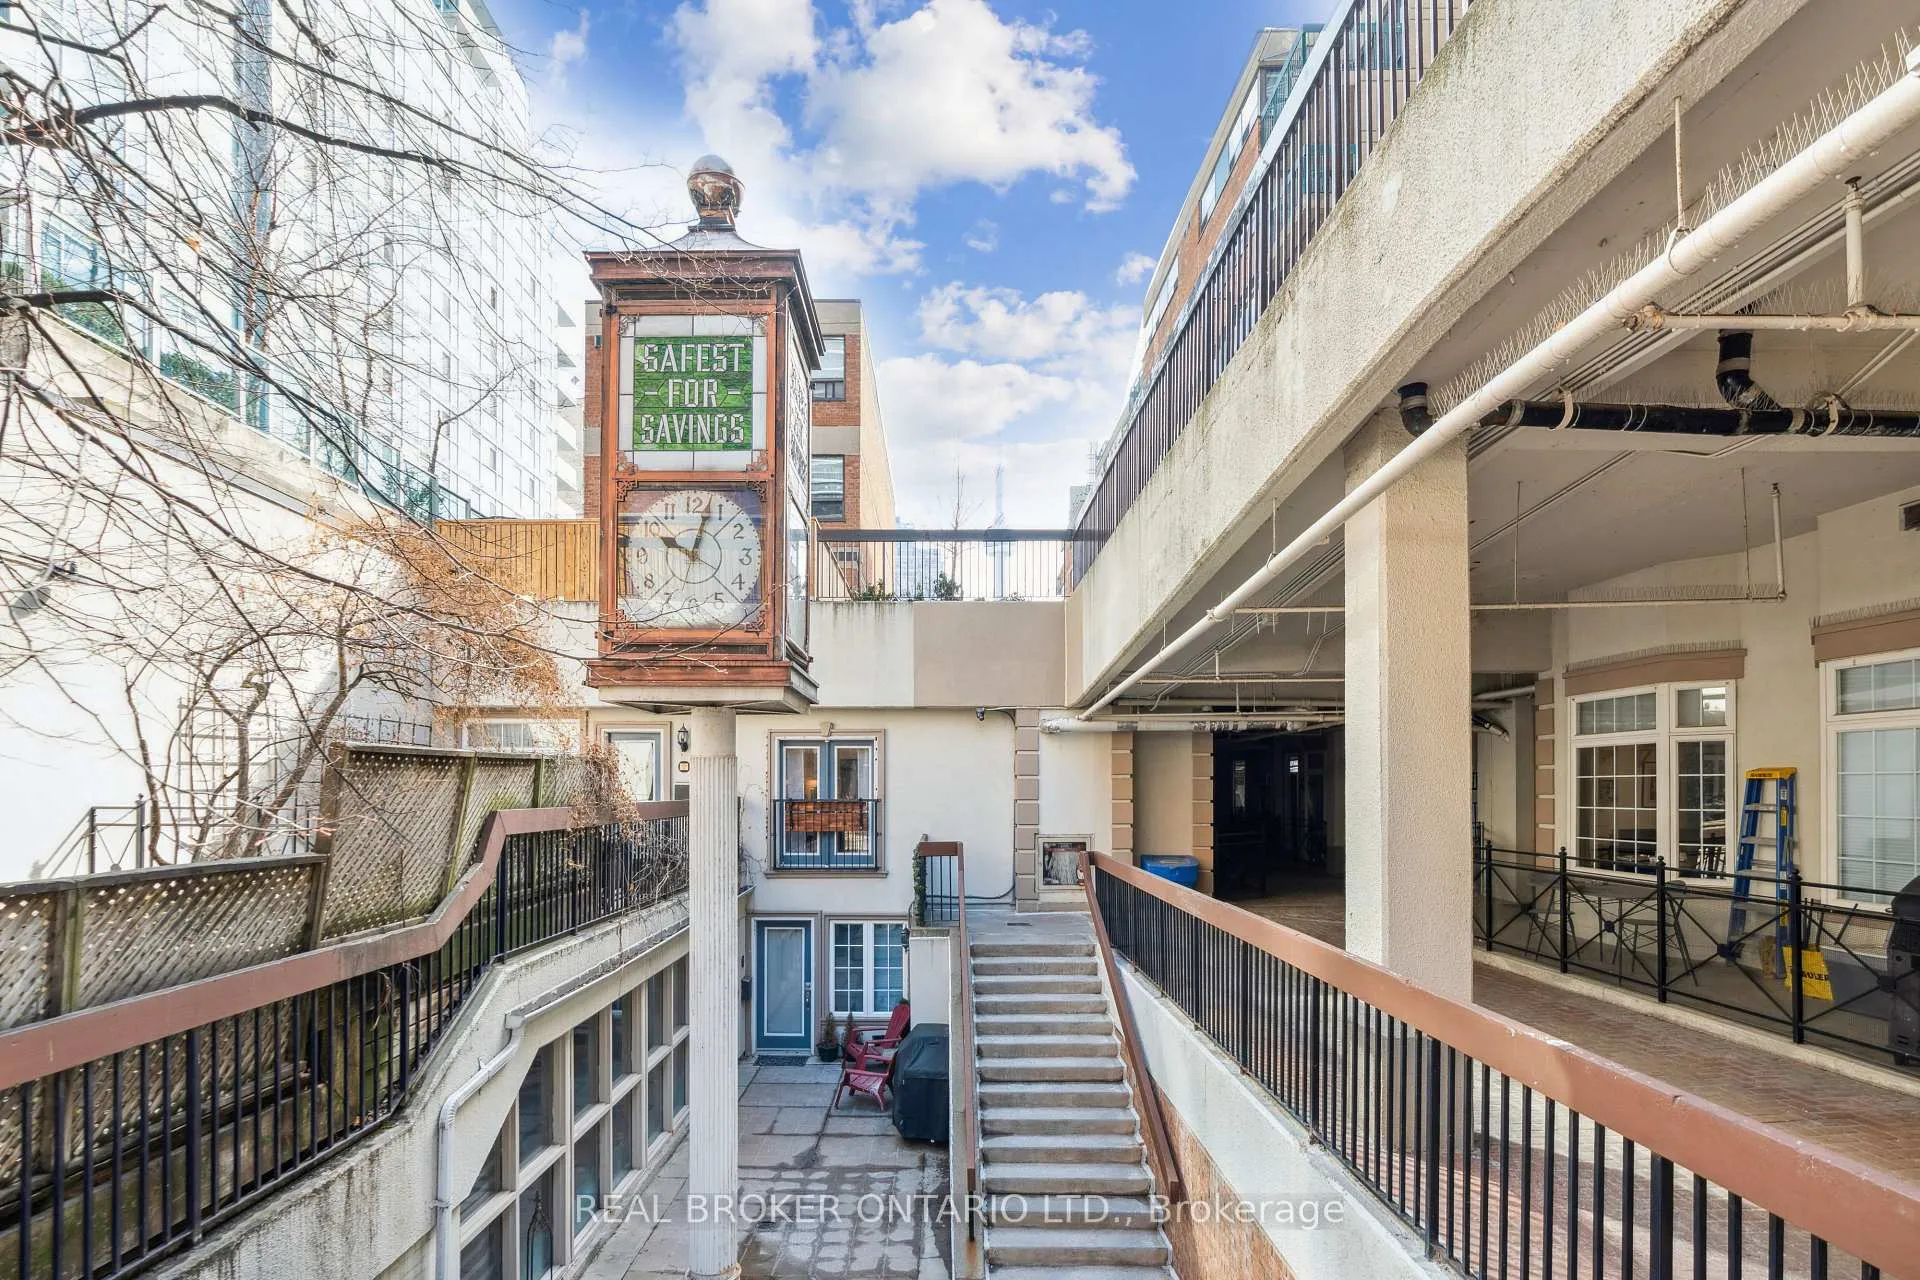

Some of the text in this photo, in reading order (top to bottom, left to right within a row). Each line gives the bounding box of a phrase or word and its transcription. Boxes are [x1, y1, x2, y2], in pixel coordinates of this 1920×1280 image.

[643, 343, 745, 372] SAFEST
[668, 378, 719, 408] FOR
[640, 413, 745, 444] SAVINGS
[664, 503, 675, 520] 11
[686, 496, 704, 514] 12
[644, 520, 660, 538] 10
[733, 523, 745, 540] 2
[636, 546, 649, 565] 9
[739, 547, 753, 566] 3
[644, 573, 655, 589] 8
[731, 573, 746, 591] 4
[714, 592, 726, 609] 5
